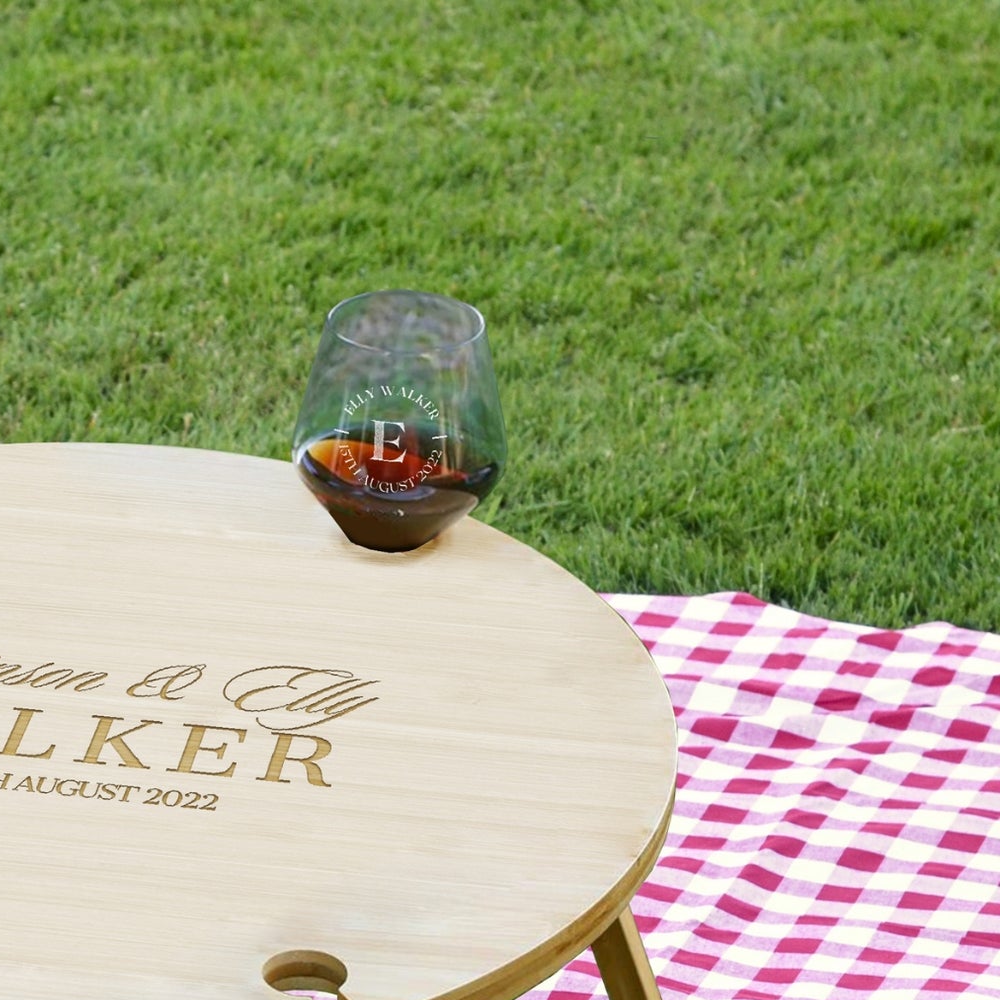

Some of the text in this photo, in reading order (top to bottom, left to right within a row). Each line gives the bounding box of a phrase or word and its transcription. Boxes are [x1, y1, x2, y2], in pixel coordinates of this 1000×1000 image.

[344, 385, 440, 420] ELLY WALKER
[370, 419, 407, 463] E
[339, 443, 443, 493] 15TH AUGUST 2022
[126, 662, 207, 701] &
[222, 664, 381, 731] Elly
[12, 773, 141, 802] AUGUST
[143, 786, 220, 812] 2022
